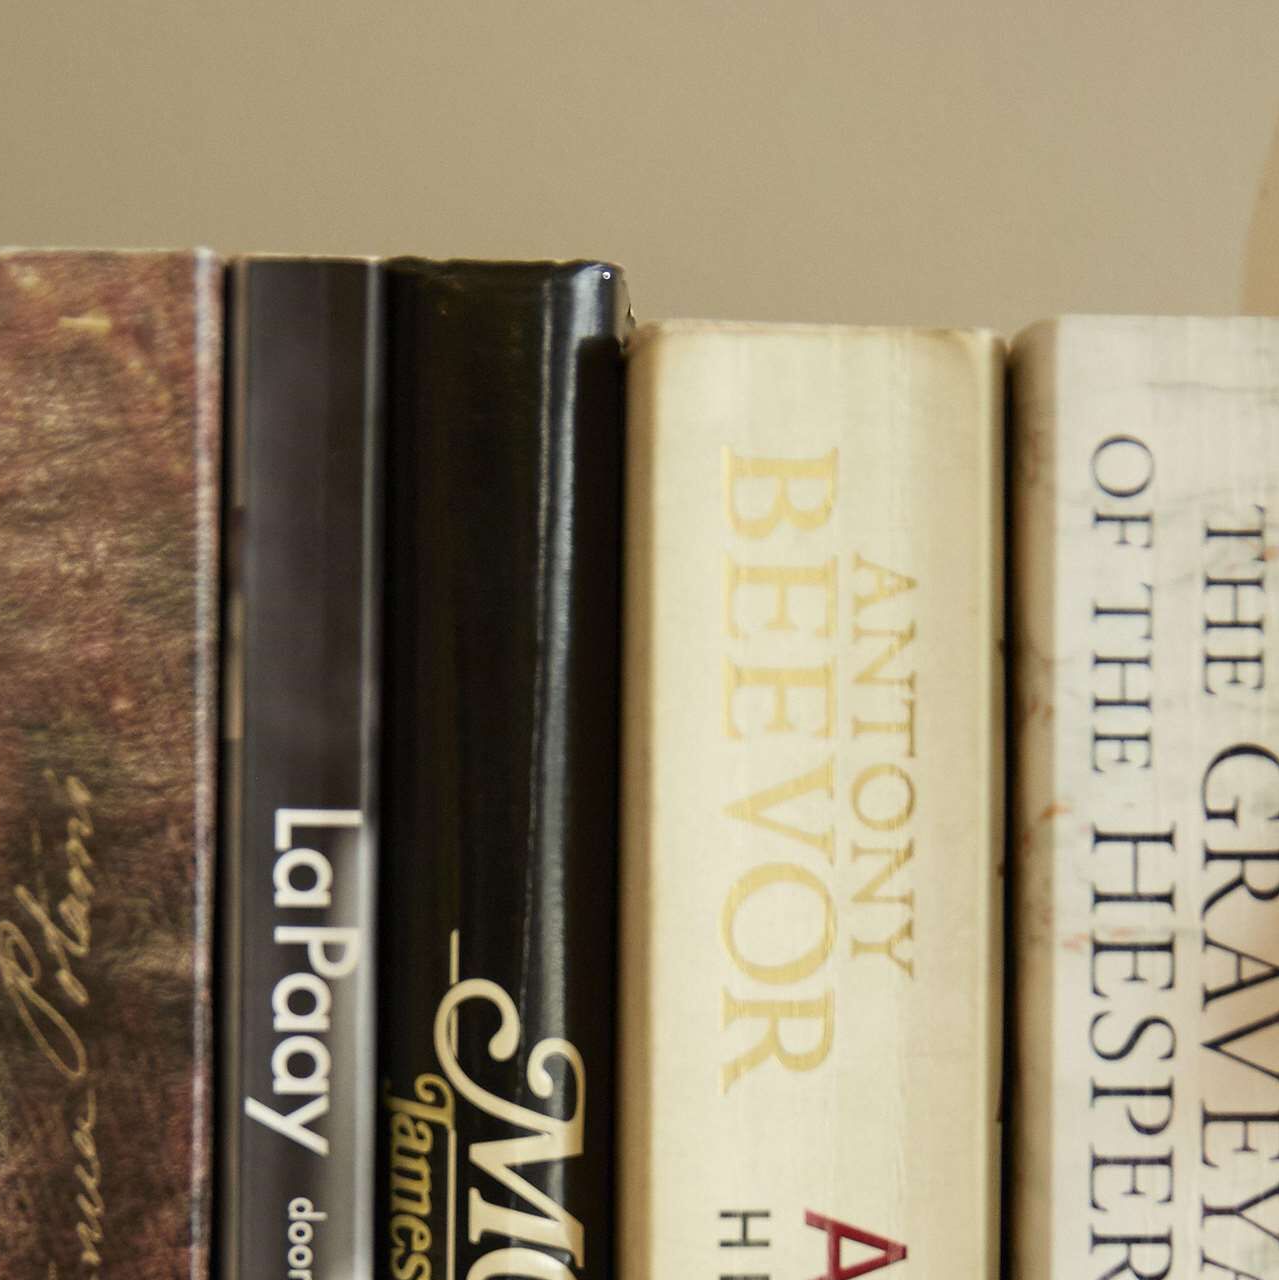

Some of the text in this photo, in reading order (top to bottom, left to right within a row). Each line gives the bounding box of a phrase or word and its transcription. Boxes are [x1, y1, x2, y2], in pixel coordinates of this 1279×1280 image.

[1090, 434, 1154, 550] OF
[1203, 504, 1267, 696] THE
[722, 446, 840, 1096] BEEVOR
[850, 551, 918, 980] ANTONY
[1092, 582, 1153, 774] THE
[244, 808, 363, 1157] La Paay
